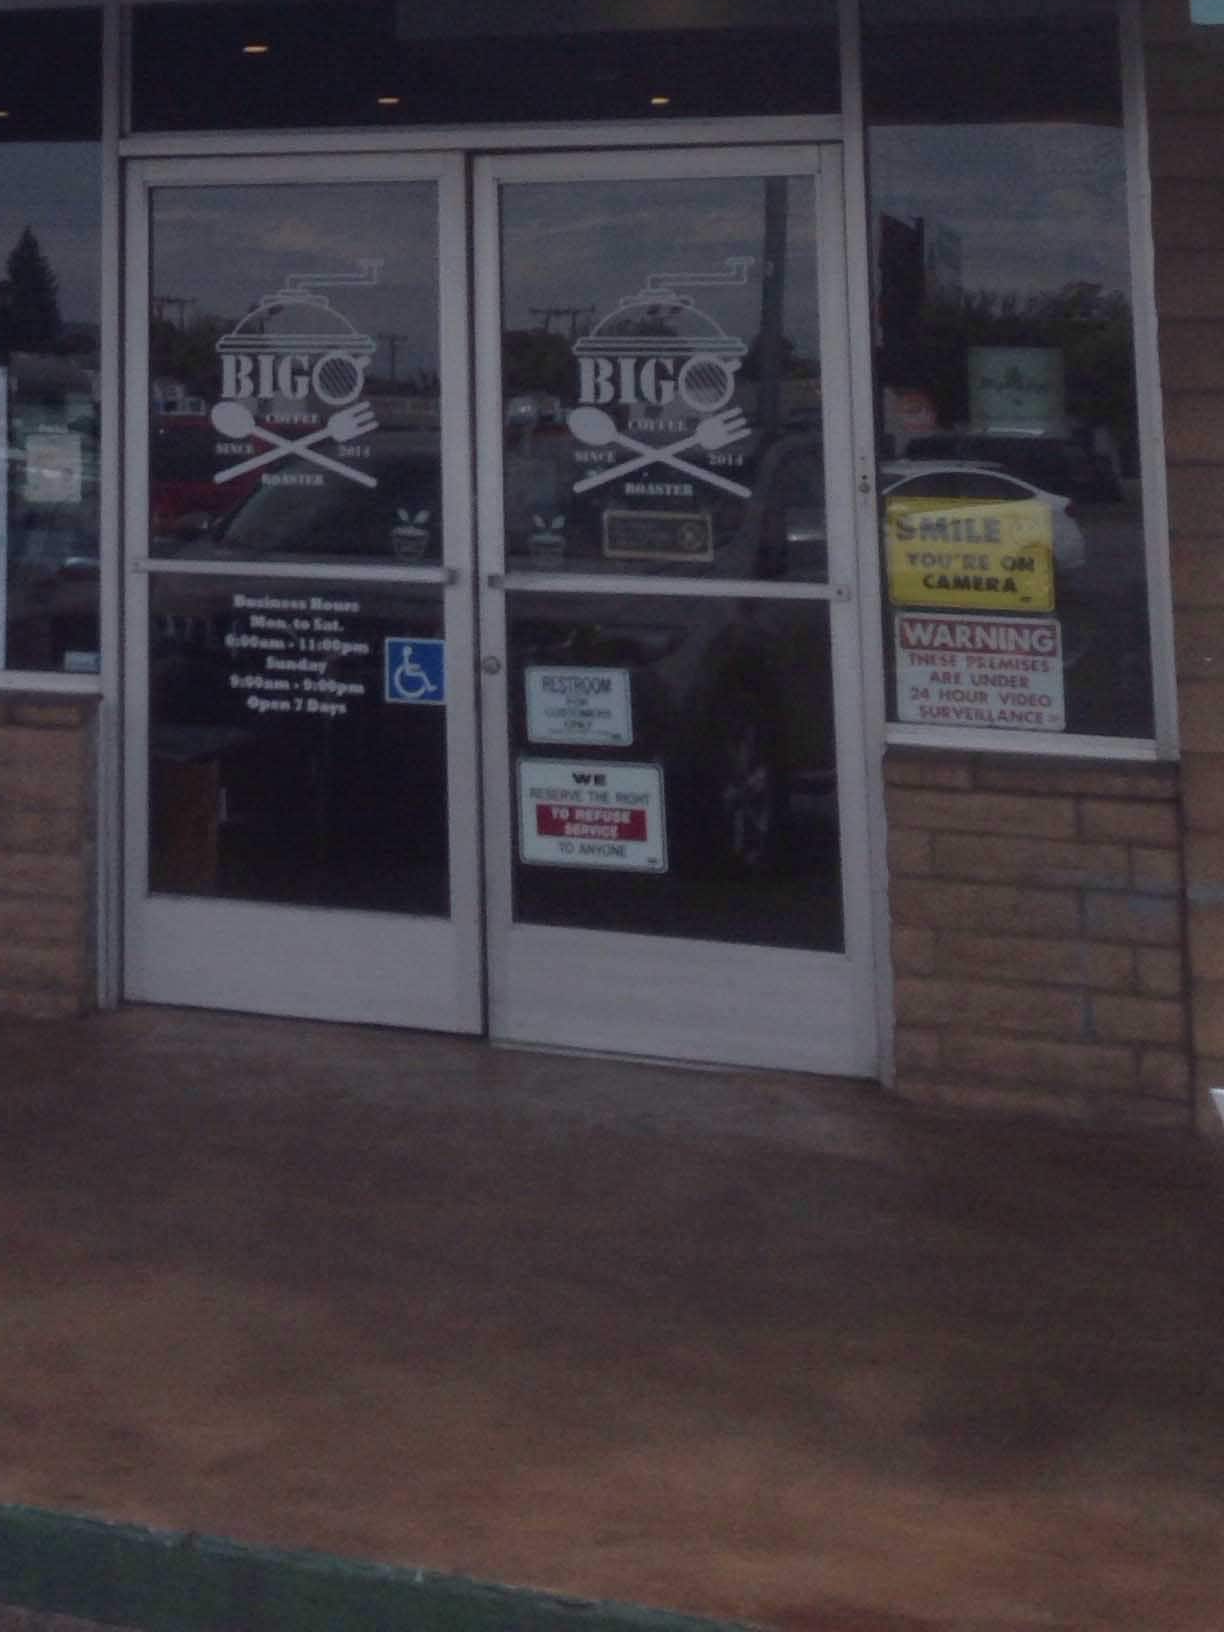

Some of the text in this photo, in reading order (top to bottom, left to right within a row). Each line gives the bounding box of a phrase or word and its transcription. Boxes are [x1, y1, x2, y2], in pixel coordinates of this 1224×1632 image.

[220, 353, 310, 400] BIG
[578, 356, 675, 405] BIG
[894, 518, 1002, 544] SMILE
[907, 552, 1036, 573] YOU'RE ON
[922, 573, 1018, 593] CAMERA
[233, 594, 361, 613] Business Hours
[293, 617, 311, 630] to
[906, 622, 1054, 652] WARNING
[266, 656, 328, 675] Sunday
[909, 653, 1051, 672] THESE PREMISES
[542, 675, 612, 695] RESTROOM
[929, 670, 1030, 689] ARE UNDER
[246, 695, 291, 713] Open
[306, 697, 347, 716] Days
[939, 689, 988, 705] HOUR
[999, 691, 1052, 708] VIDEO
[919, 704, 1044, 725] SURVEILLANCE
[572, 772, 607, 786] WE
[589, 790, 610, 802] THE
